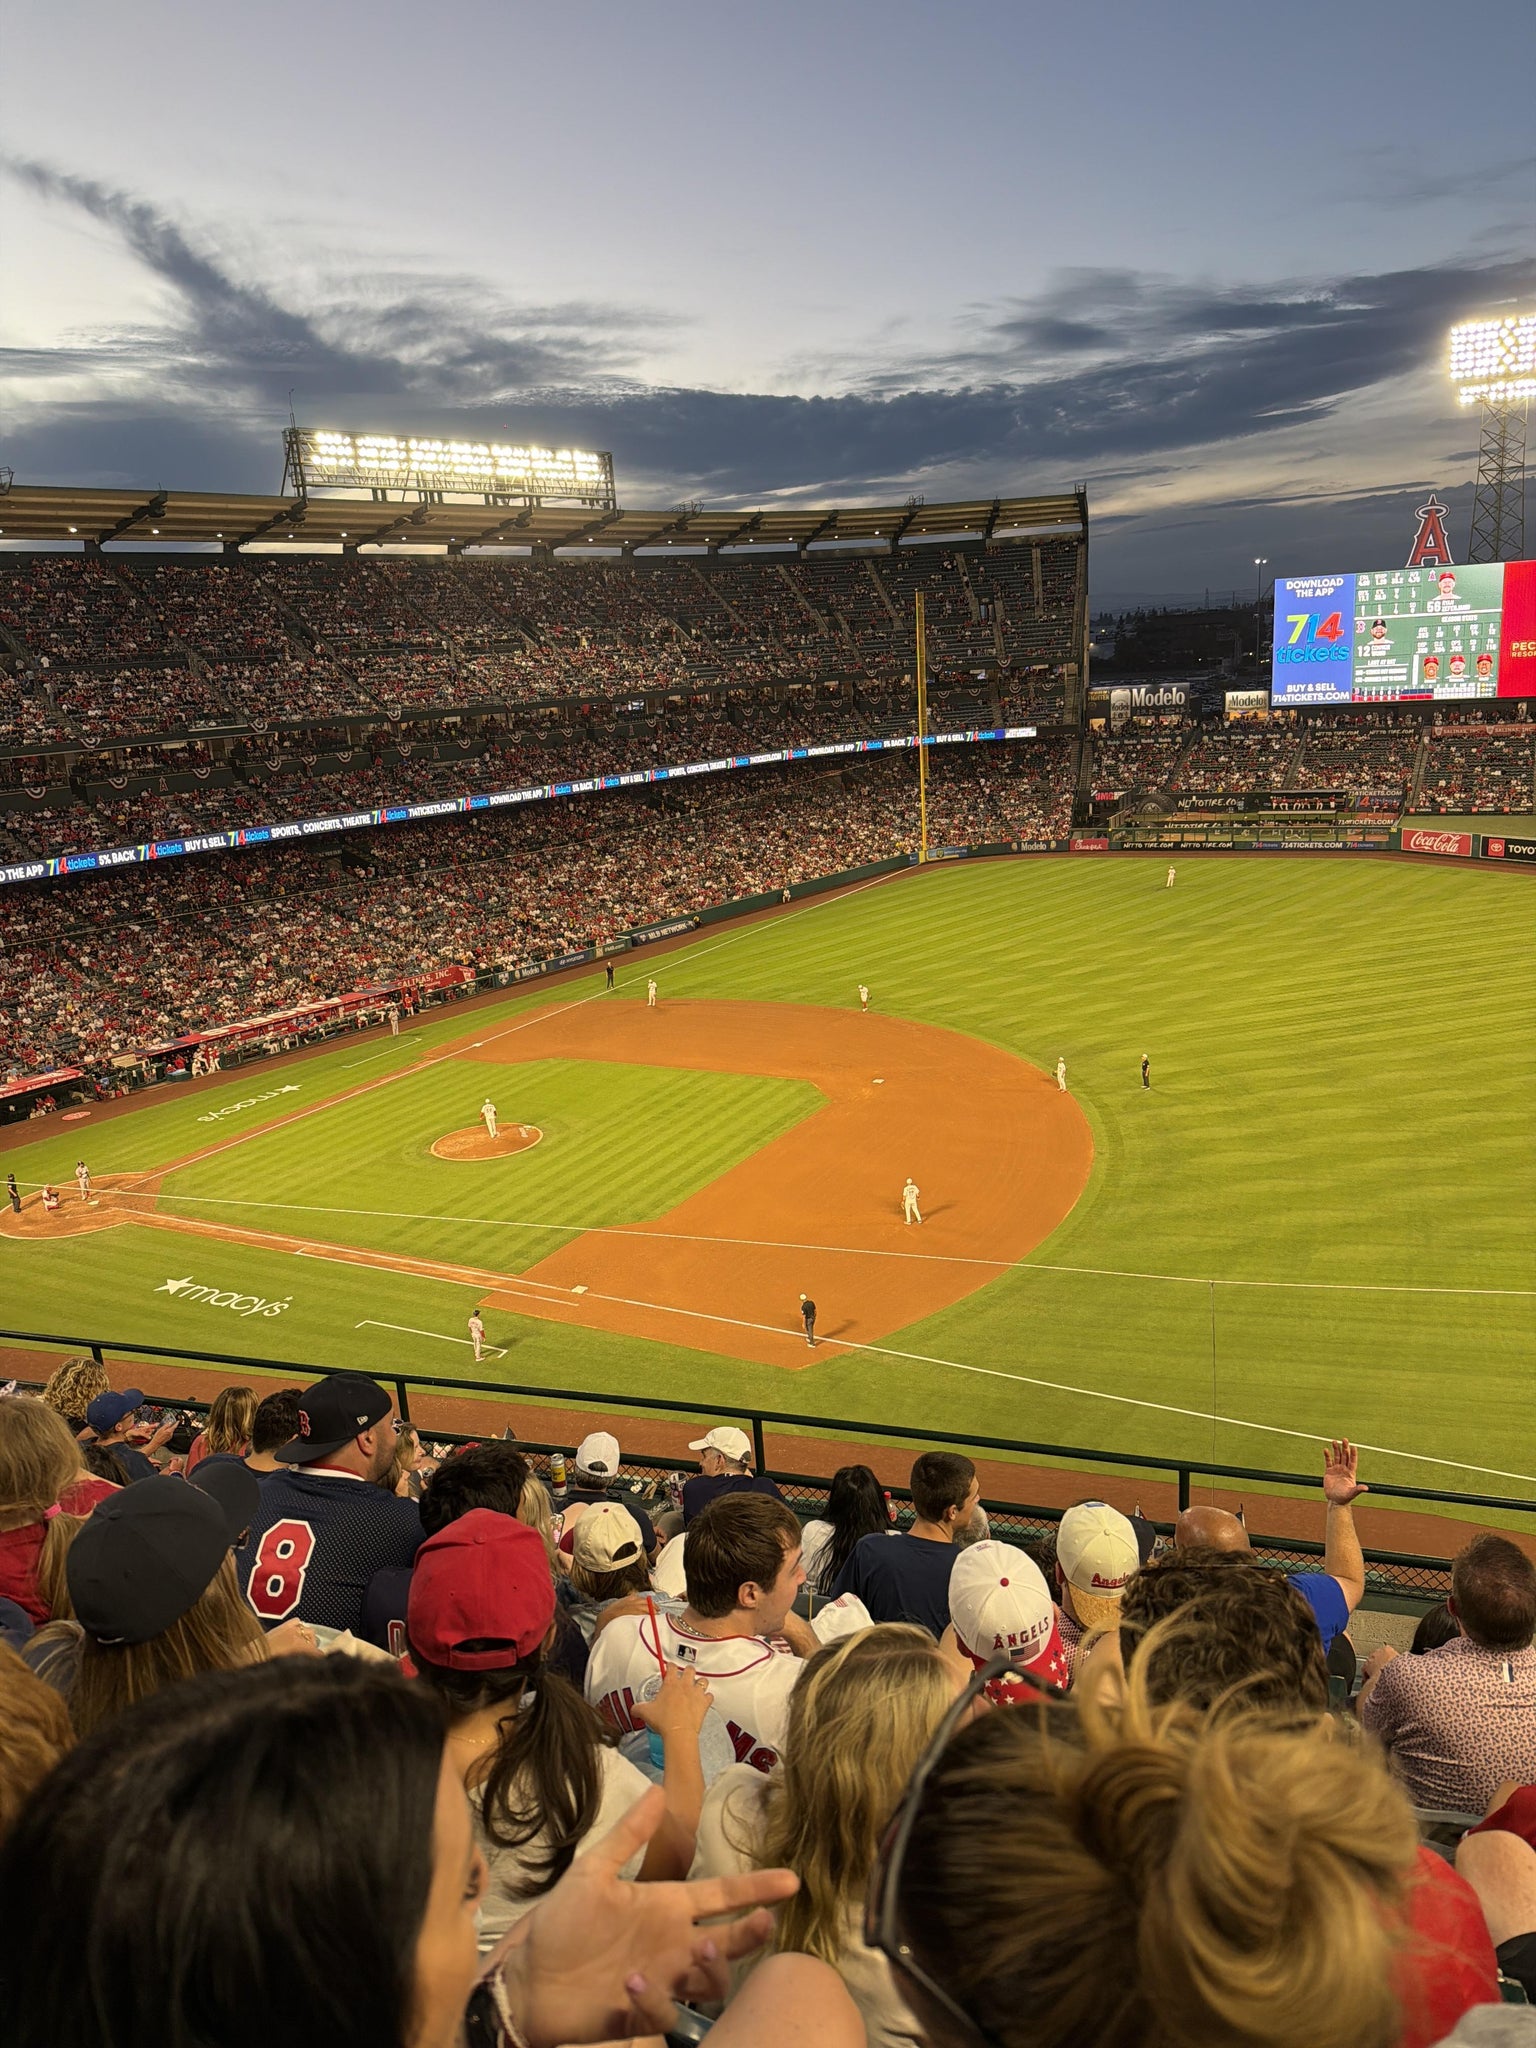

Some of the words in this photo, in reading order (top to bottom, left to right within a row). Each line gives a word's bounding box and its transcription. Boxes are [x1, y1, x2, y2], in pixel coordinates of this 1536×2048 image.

[1405, 494, 1455, 568] A
[1286, 578, 1344, 590] DOWNLOAD
[1296, 589, 1313, 598] THE
[1315, 587, 1334, 596] APP
[1287, 612, 1344, 644] 714
[1276, 642, 1350, 664] tickets
[1357, 645, 1370, 657] 12
[1287, 684, 1306, 693] BUY
[1308, 683, 1314, 692] &
[1315, 683, 1336, 691] SELL
[1132, 687, 1185, 708] Modelo
[1231, 694, 1265, 706] Modelo
[1273, 692, 1350, 703] 714TICKETS.COM
[6, 868, 25, 880] THE
[26, 864, 44, 877] APP
[99, 855, 111, 865] 5%
[112, 850, 136, 864] BACK
[185, 839, 202, 851] BUY
[202, 839, 208, 849] &
[208, 836, 226, 847] SELL
[271, 825, 301, 838] SPORTS,
[303, 819, 342, 833] CONCERTS,
[342, 814, 371, 827] THEATRE
[490, 792, 521, 805] DOWNLOAD
[522, 791, 532, 799] THE
[533, 789, 542, 799] APP
[580, 782, 593, 791] BACK
[1021, 841, 1047, 851] Modelo
[1410, 832, 1462, 853] Coca-Cola
[648, 931, 660, 939] MLB
[661, 923, 686, 936] NETWORK
[435, 970, 451, 979] INC.
[522, 968, 540, 977] Modelo
[247, 1518, 316, 1620] 8
[993, 1616, 1049, 1650] ANGELS
